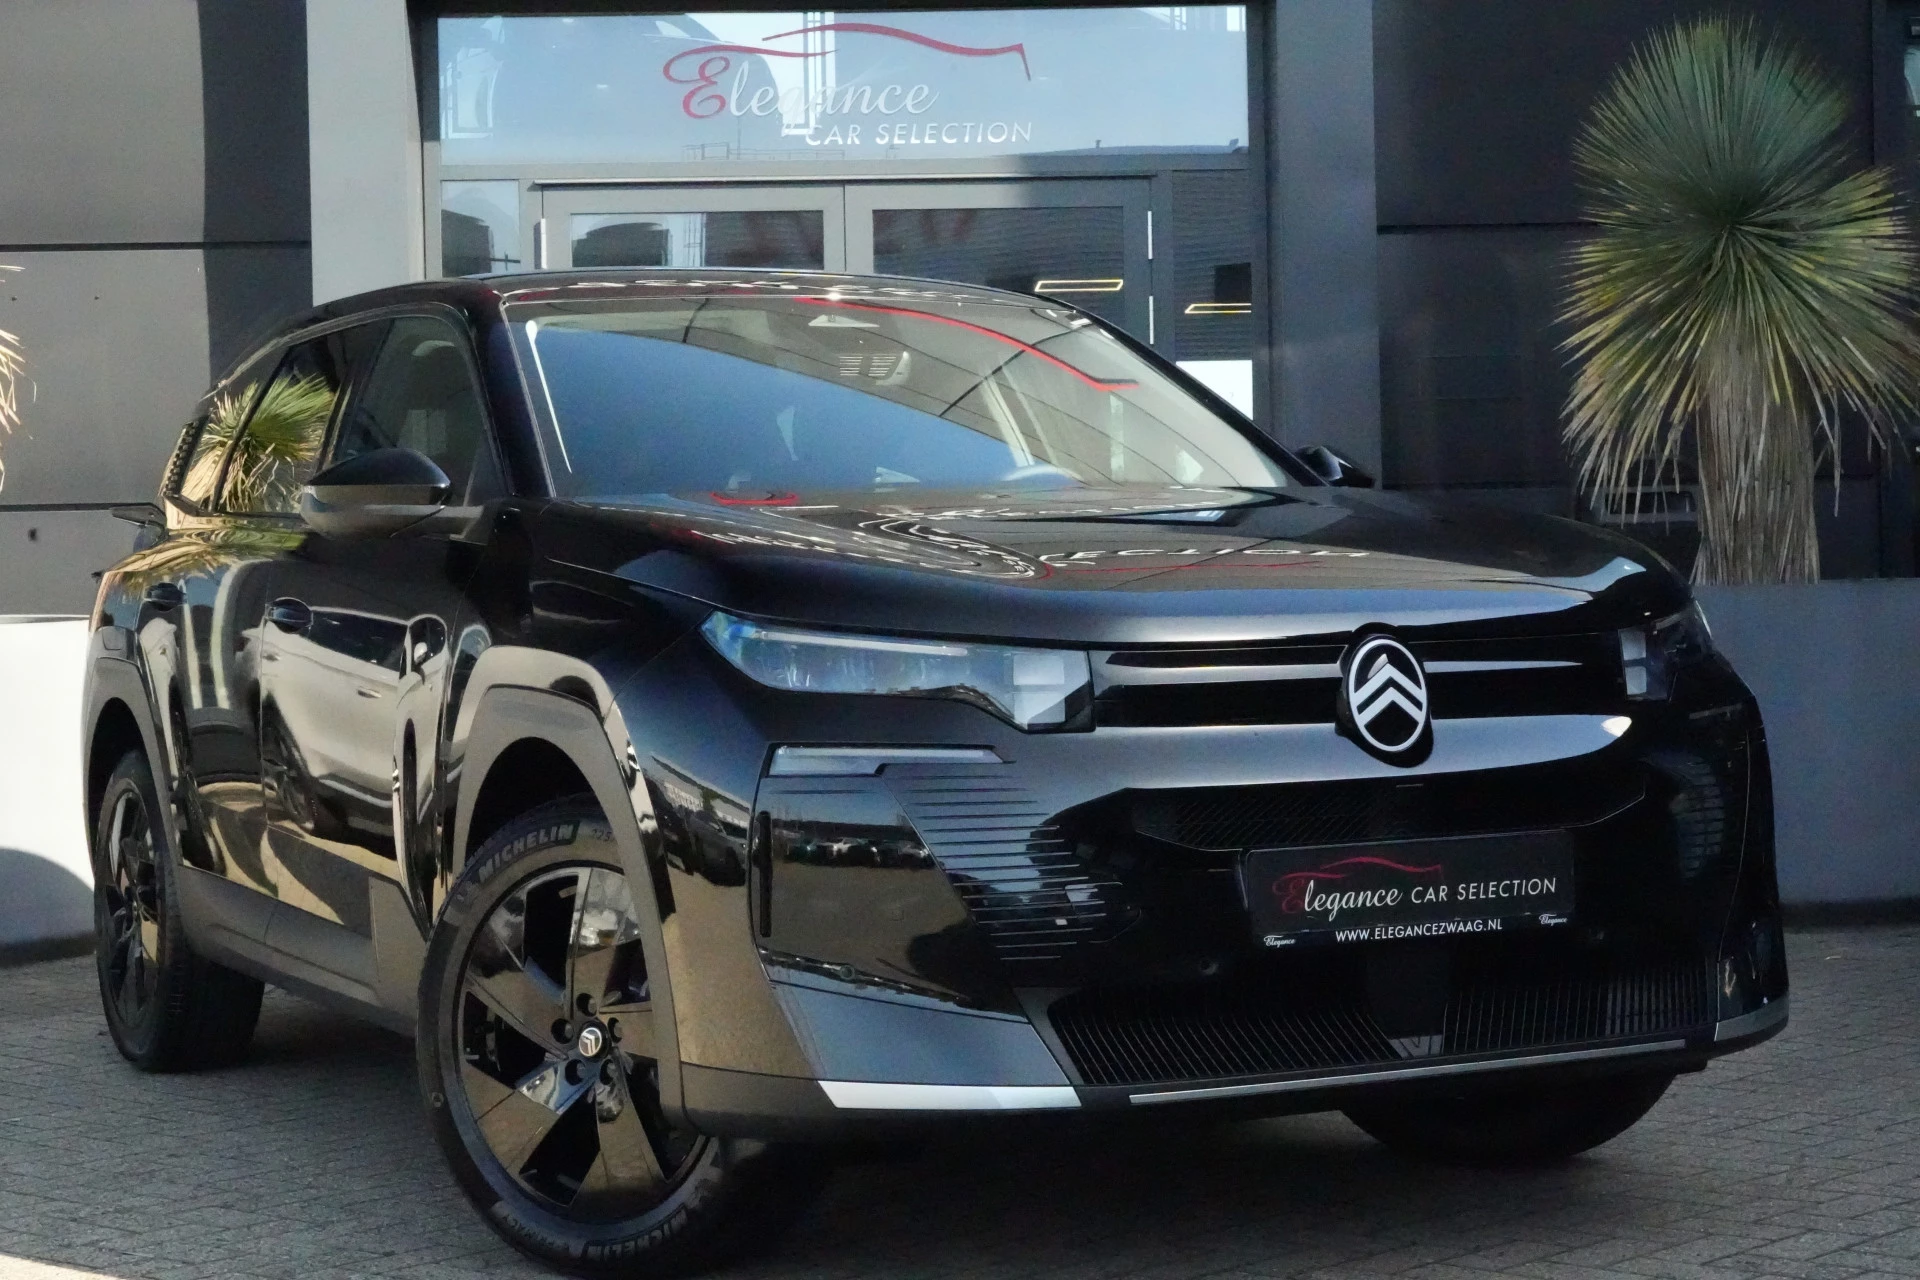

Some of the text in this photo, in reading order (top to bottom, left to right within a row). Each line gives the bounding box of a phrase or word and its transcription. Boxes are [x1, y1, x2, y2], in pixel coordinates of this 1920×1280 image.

[663, 45, 939, 132] Elegance
[805, 121, 1032, 146] CAR SELECTION
[477, 823, 576, 884] MICHELIN
[1272, 872, 1557, 921] Elegance CAR SELECTION
[1263, 934, 1297, 948] Elegance
[1335, 918, 1503, 943] WWW.ELEGANCEZWAAG.NL
